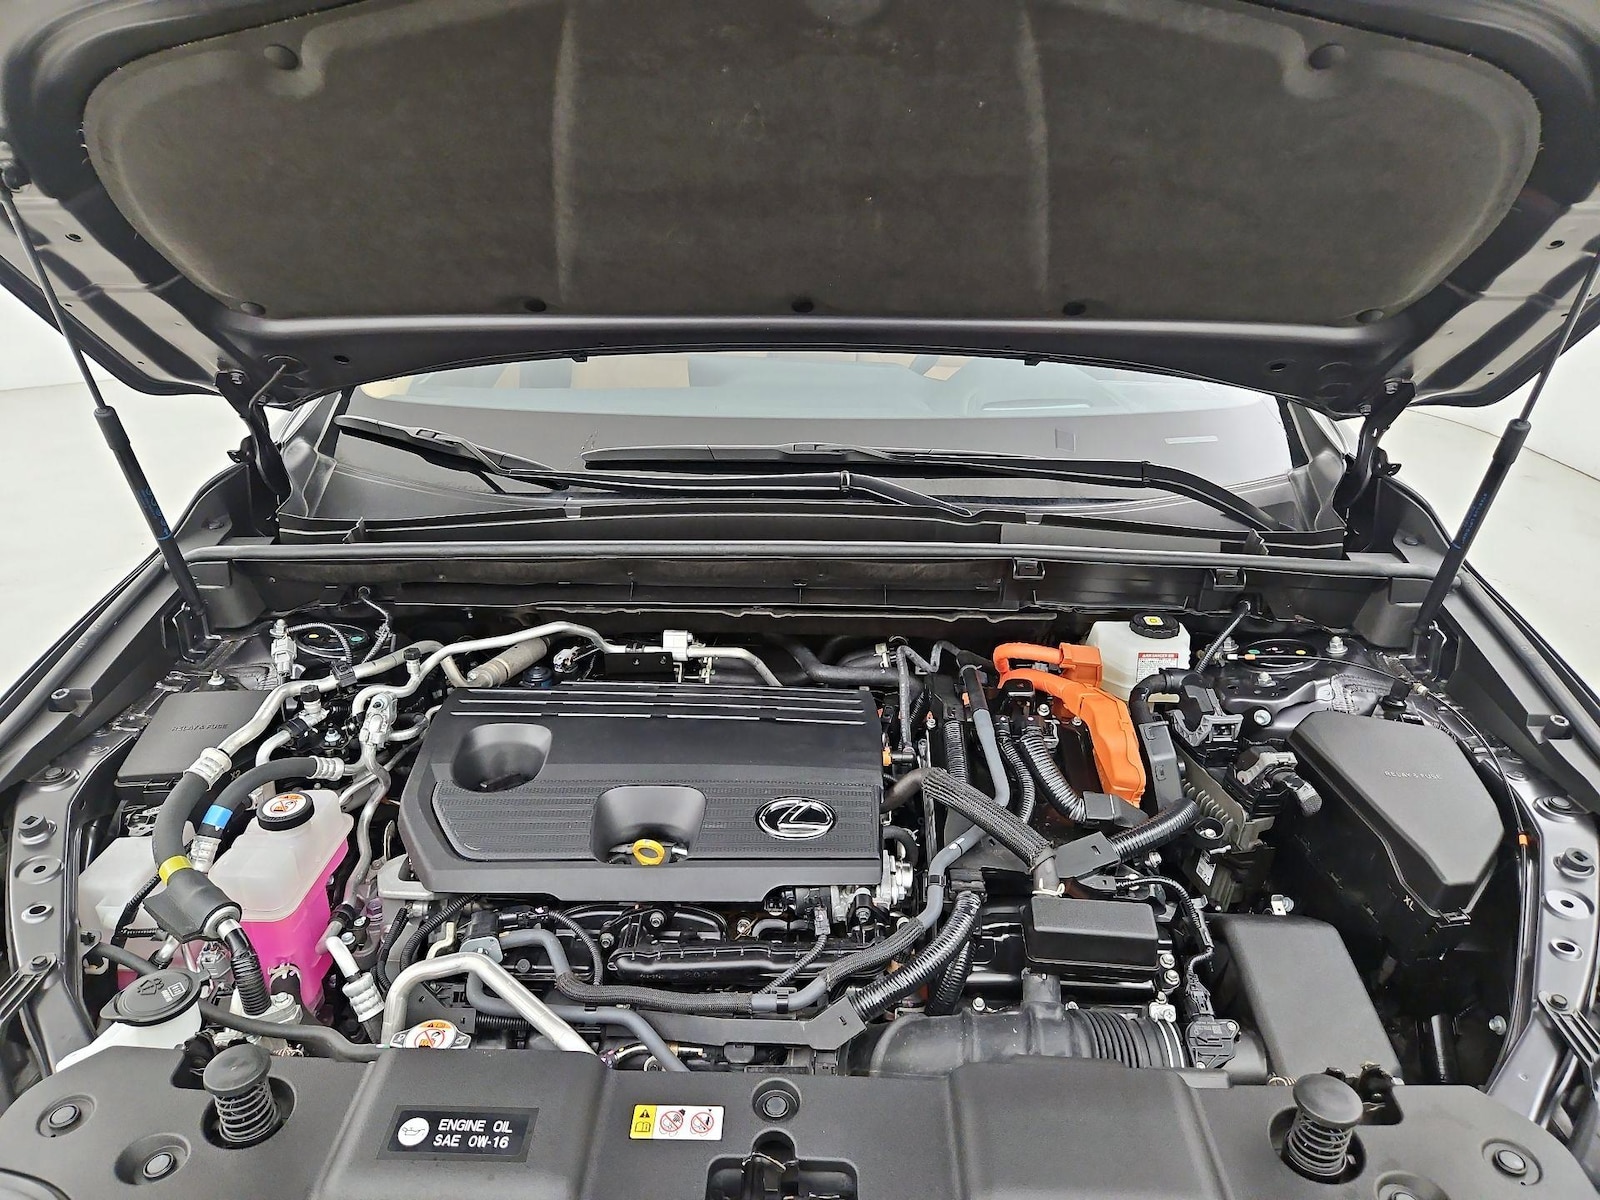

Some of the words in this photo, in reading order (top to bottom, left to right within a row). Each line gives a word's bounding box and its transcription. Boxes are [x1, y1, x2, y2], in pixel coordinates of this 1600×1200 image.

[438, 1118, 487, 1132] ENGINE
[493, 1120, 513, 1134] OIL
[433, 1134, 462, 1147] SAE
[467, 1135, 510, 1149] 0W-16
